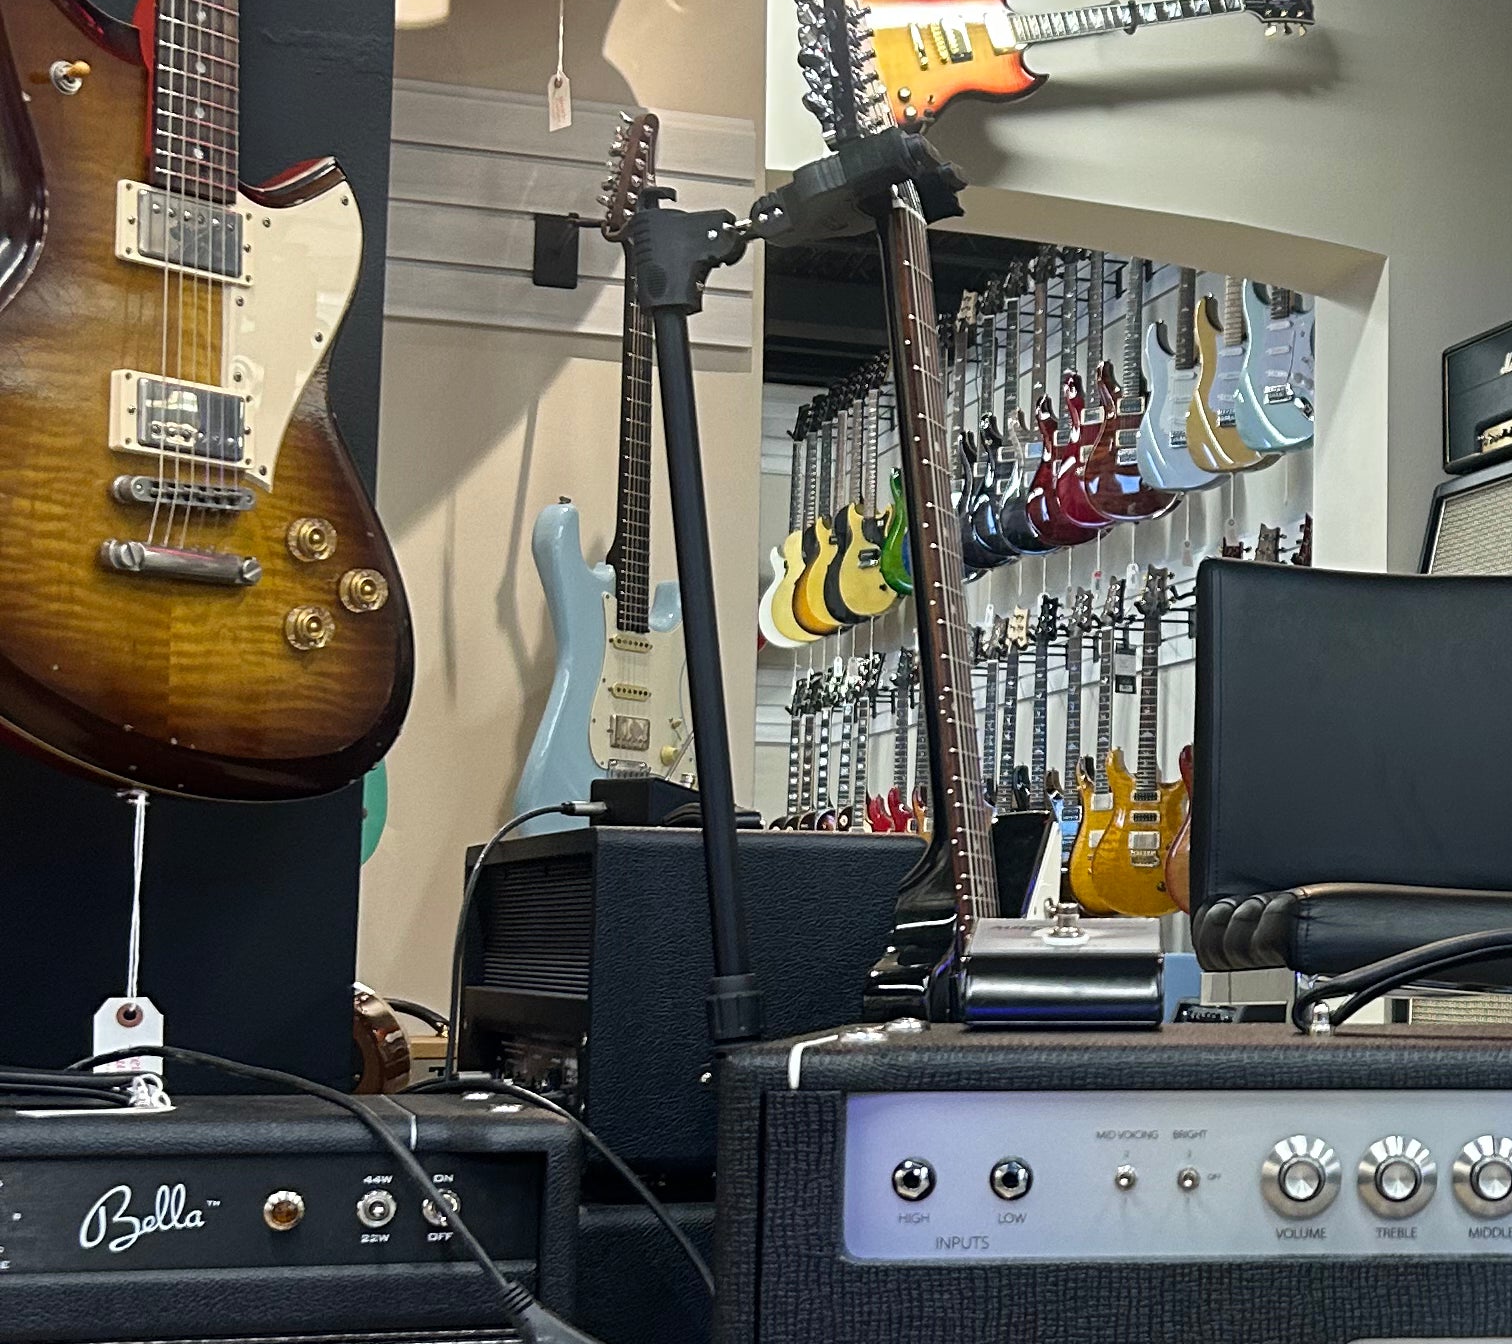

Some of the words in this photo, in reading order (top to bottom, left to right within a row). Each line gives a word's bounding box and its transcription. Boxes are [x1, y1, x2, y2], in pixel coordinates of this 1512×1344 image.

[1096, 1130, 1117, 1139] MID
[1118, 1129, 1160, 1140] VOICING
[1172, 1129, 1208, 1140] BRIGHT
[363, 1174, 393, 1184] 44W
[433, 1174, 454, 1183] ON
[79, 1183, 205, 1253] Bella
[898, 1212, 931, 1224] HIGH
[998, 1212, 1028, 1224] LOW
[361, 1233, 390, 1243] 22W
[427, 1232, 453, 1242] OFF
[1275, 1226, 1327, 1239] VOLUME
[1376, 1226, 1418, 1239] TREBLE
[935, 1236, 991, 1251] INPUTS
